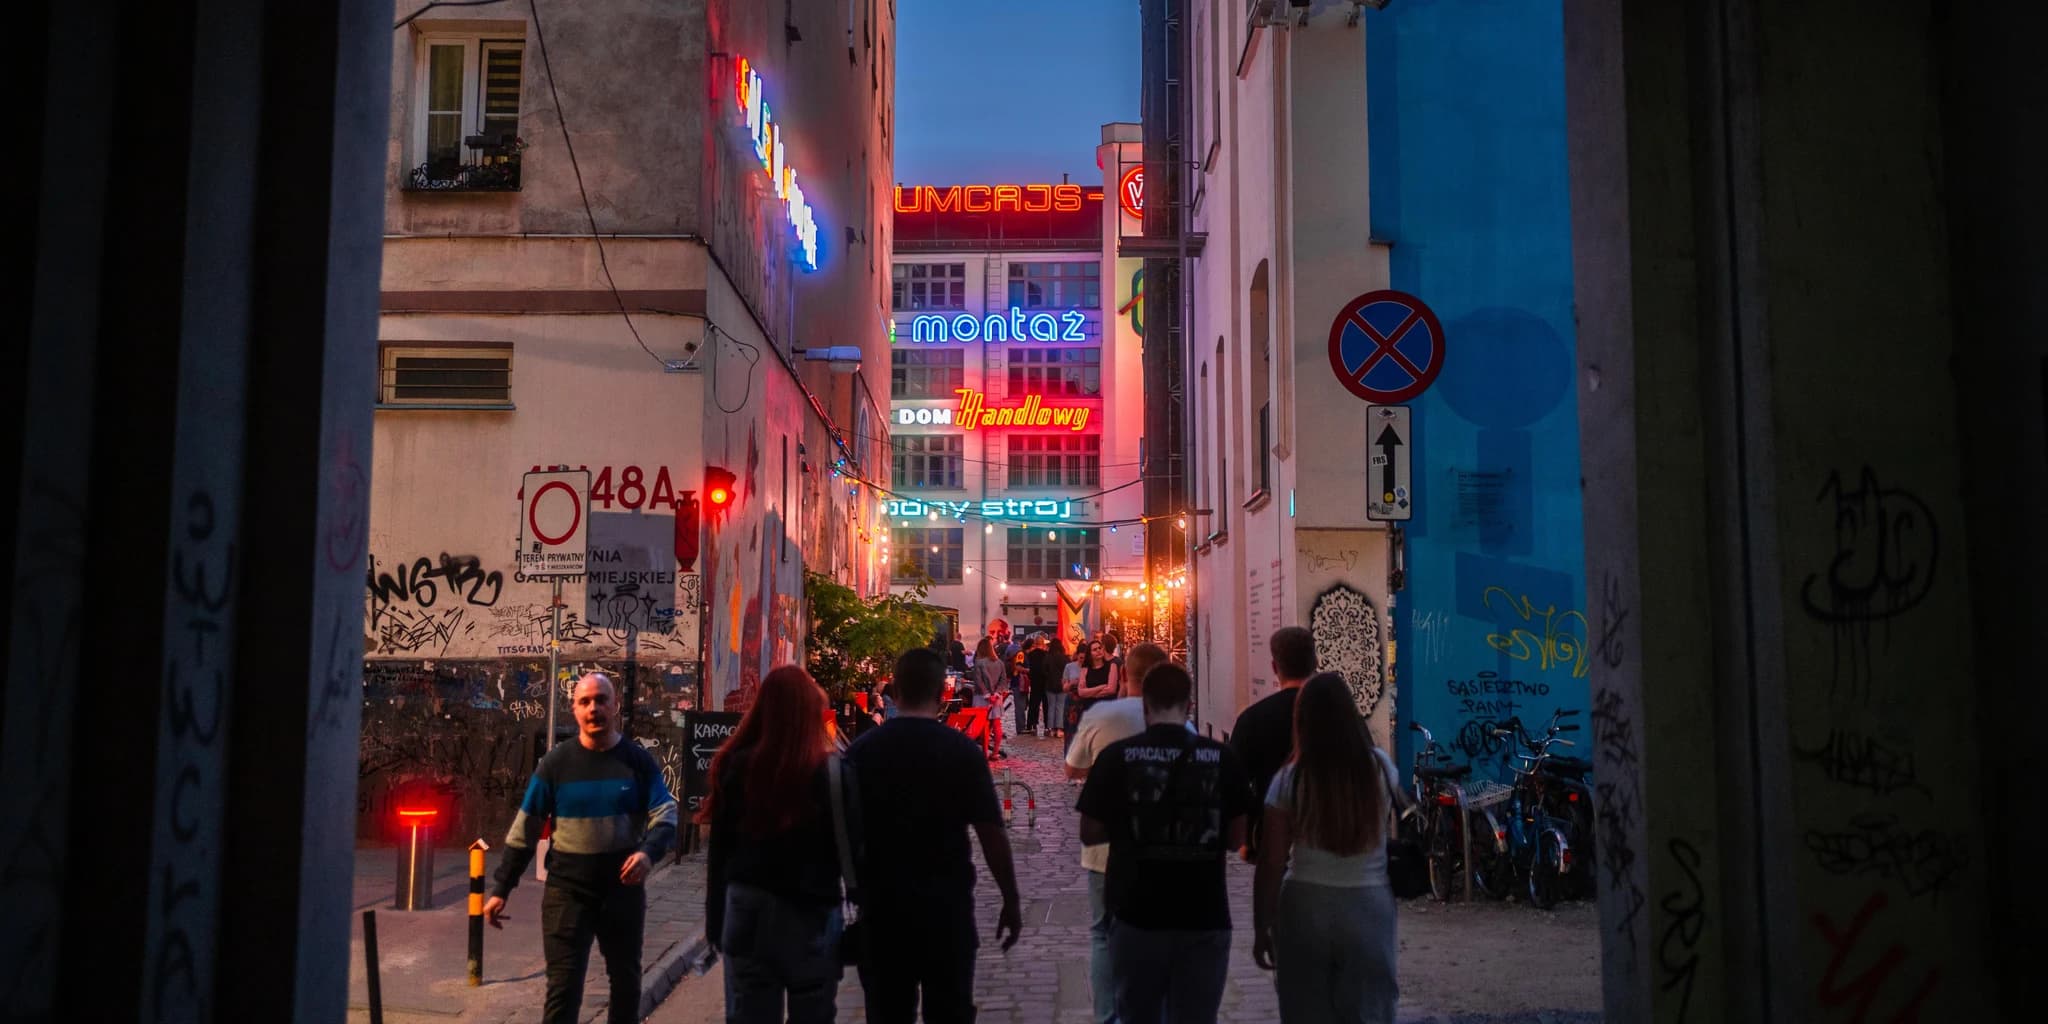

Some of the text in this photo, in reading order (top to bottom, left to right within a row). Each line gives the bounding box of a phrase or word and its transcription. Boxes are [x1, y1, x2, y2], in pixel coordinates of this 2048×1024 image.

[912, 306, 1086, 343] montaż
[899, 388, 1090, 431] DOM Handlowy
[522, 553, 545, 563] TEREN
[547, 552, 585, 562] PRYWATNY
[588, 571, 676, 584] MIEJSKIEJ
[1195, 748, 1221, 764] NOW
